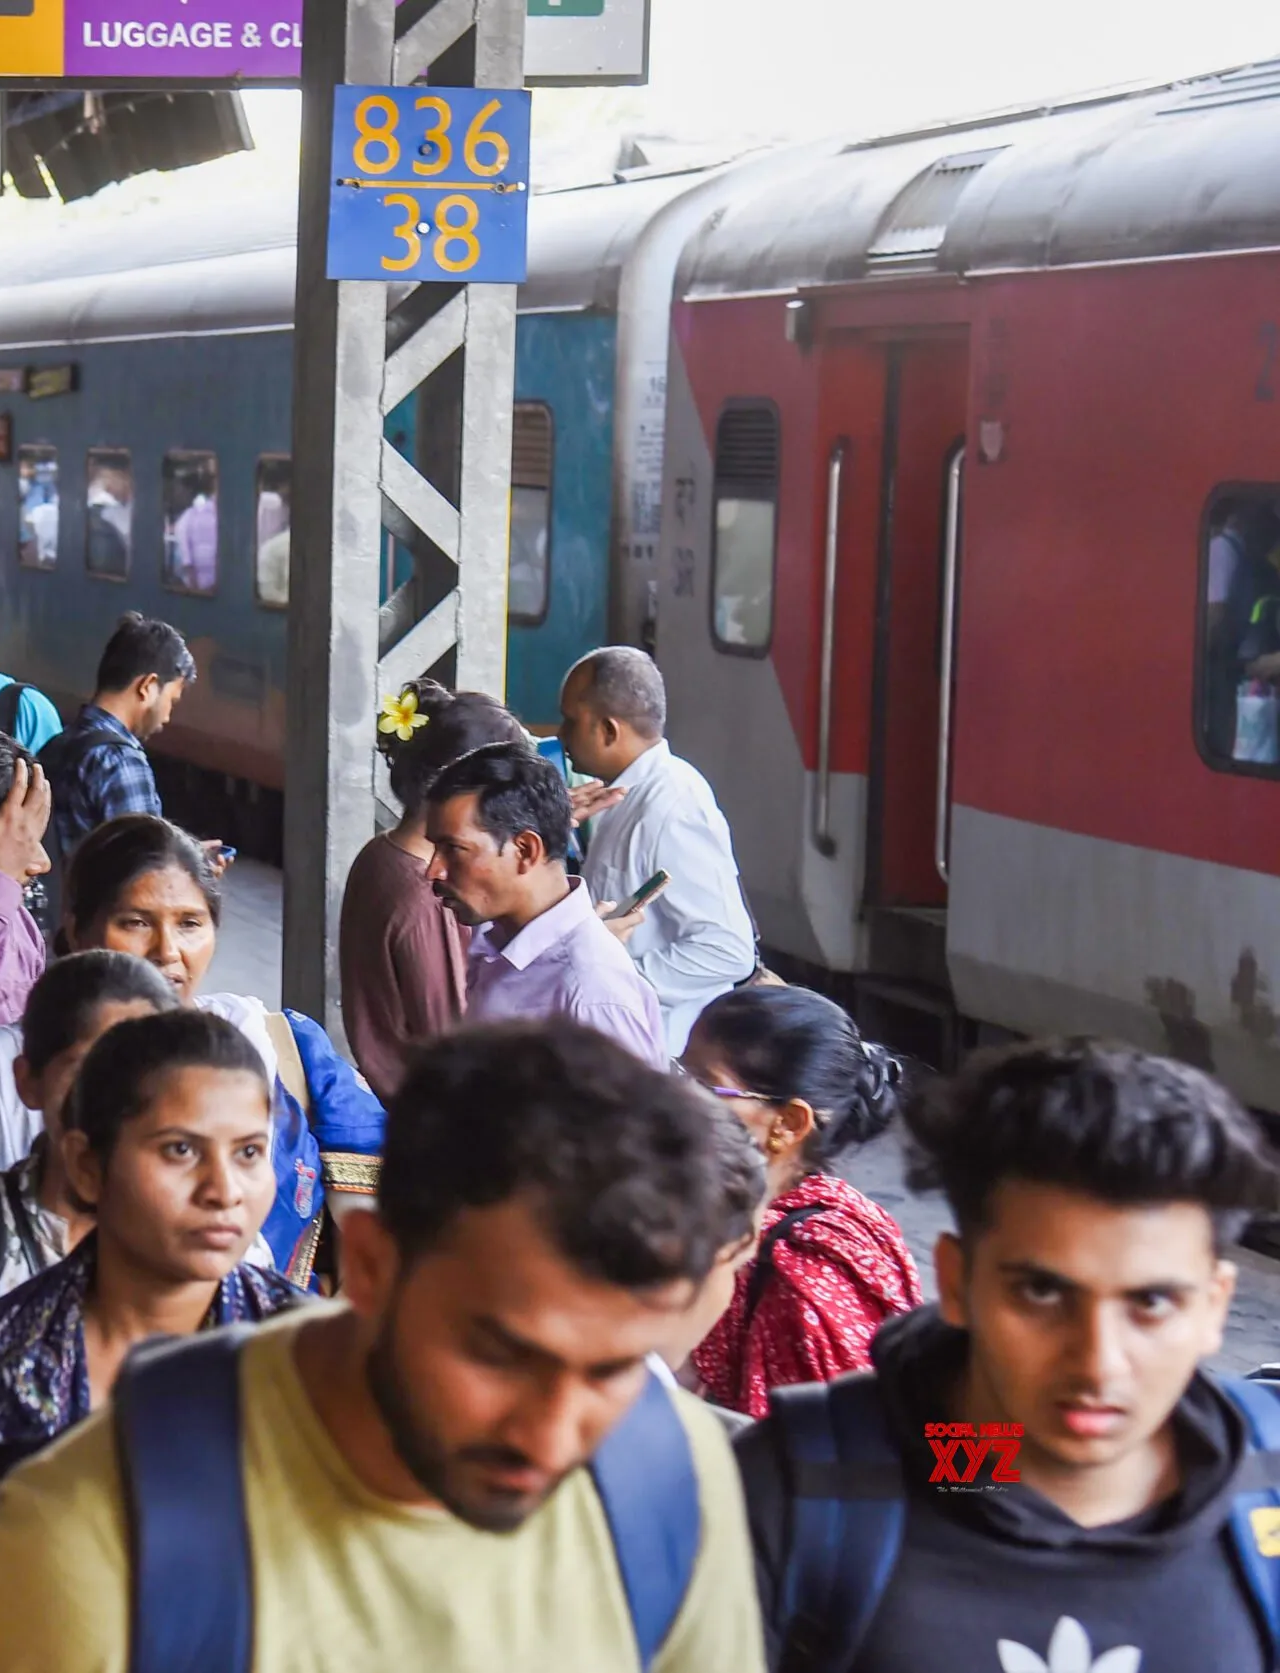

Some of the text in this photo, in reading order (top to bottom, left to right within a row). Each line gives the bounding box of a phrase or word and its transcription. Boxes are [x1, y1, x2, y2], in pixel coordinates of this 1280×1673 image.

[82, 21, 233, 48] LUGGAGE
[240, 22, 262, 48] &
[352, 95, 510, 177] 836
[380, 193, 481, 273] 38
